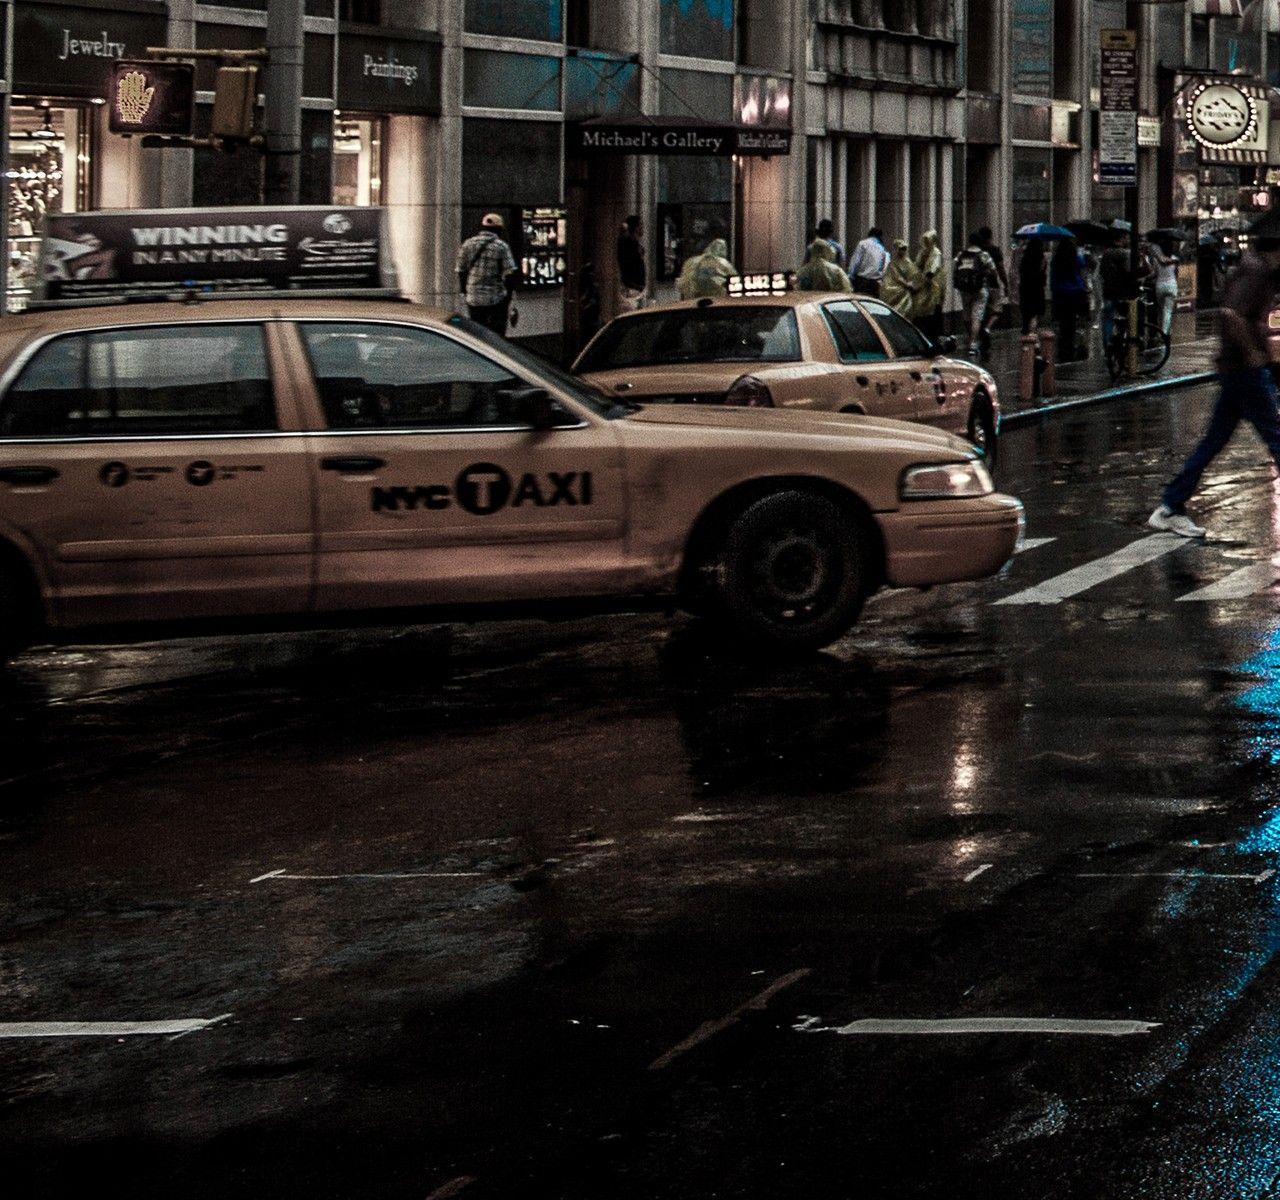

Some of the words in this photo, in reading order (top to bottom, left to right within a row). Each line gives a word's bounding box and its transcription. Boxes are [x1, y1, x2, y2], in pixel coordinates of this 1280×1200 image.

[59, 29, 126, 60] Jewelry
[364, 54, 418, 87] Paintings
[582, 131, 660, 148] Michael's
[662, 132, 723, 152] Gallery
[131, 224, 288, 246] WINNING
[371, 485, 450, 511] NYC
[457, 462, 594, 515] TAXI
